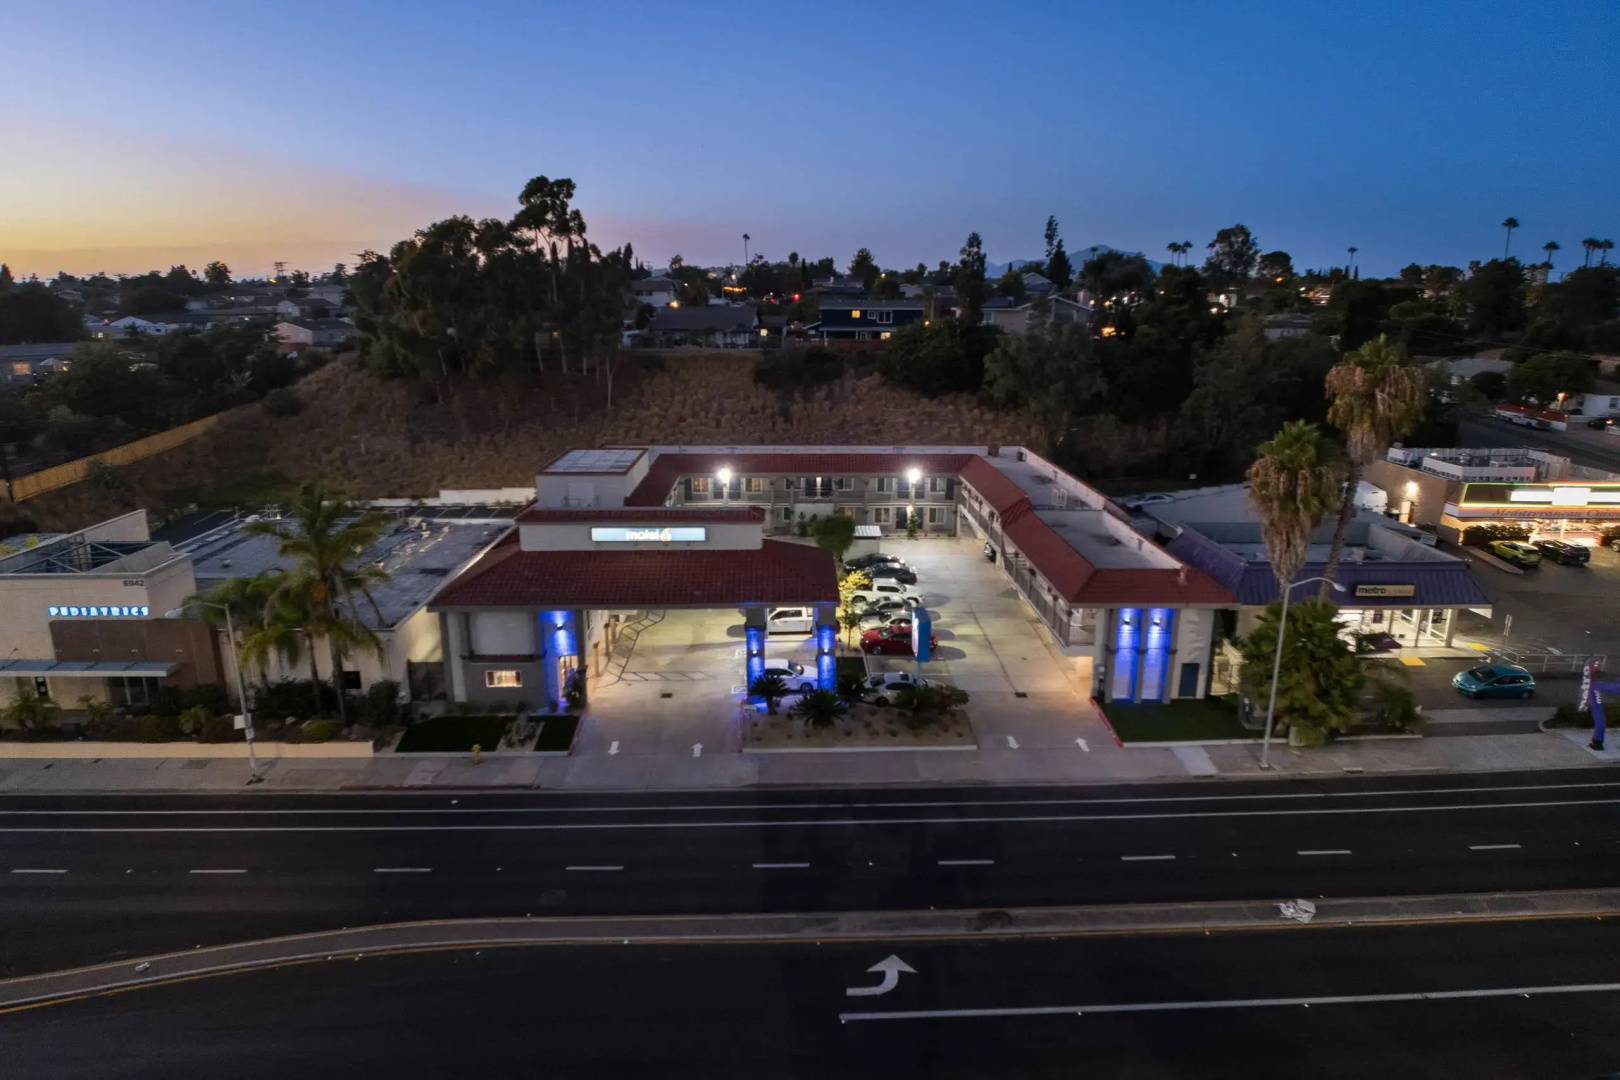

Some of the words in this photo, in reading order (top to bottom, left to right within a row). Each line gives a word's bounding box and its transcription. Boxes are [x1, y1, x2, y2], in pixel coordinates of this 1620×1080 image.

[1492, 508, 1580, 518] Mediterranean
[626, 529, 660, 540] motel
[660, 527, 672, 541] 6
[48, 606, 149, 616] PEDIATRICS
